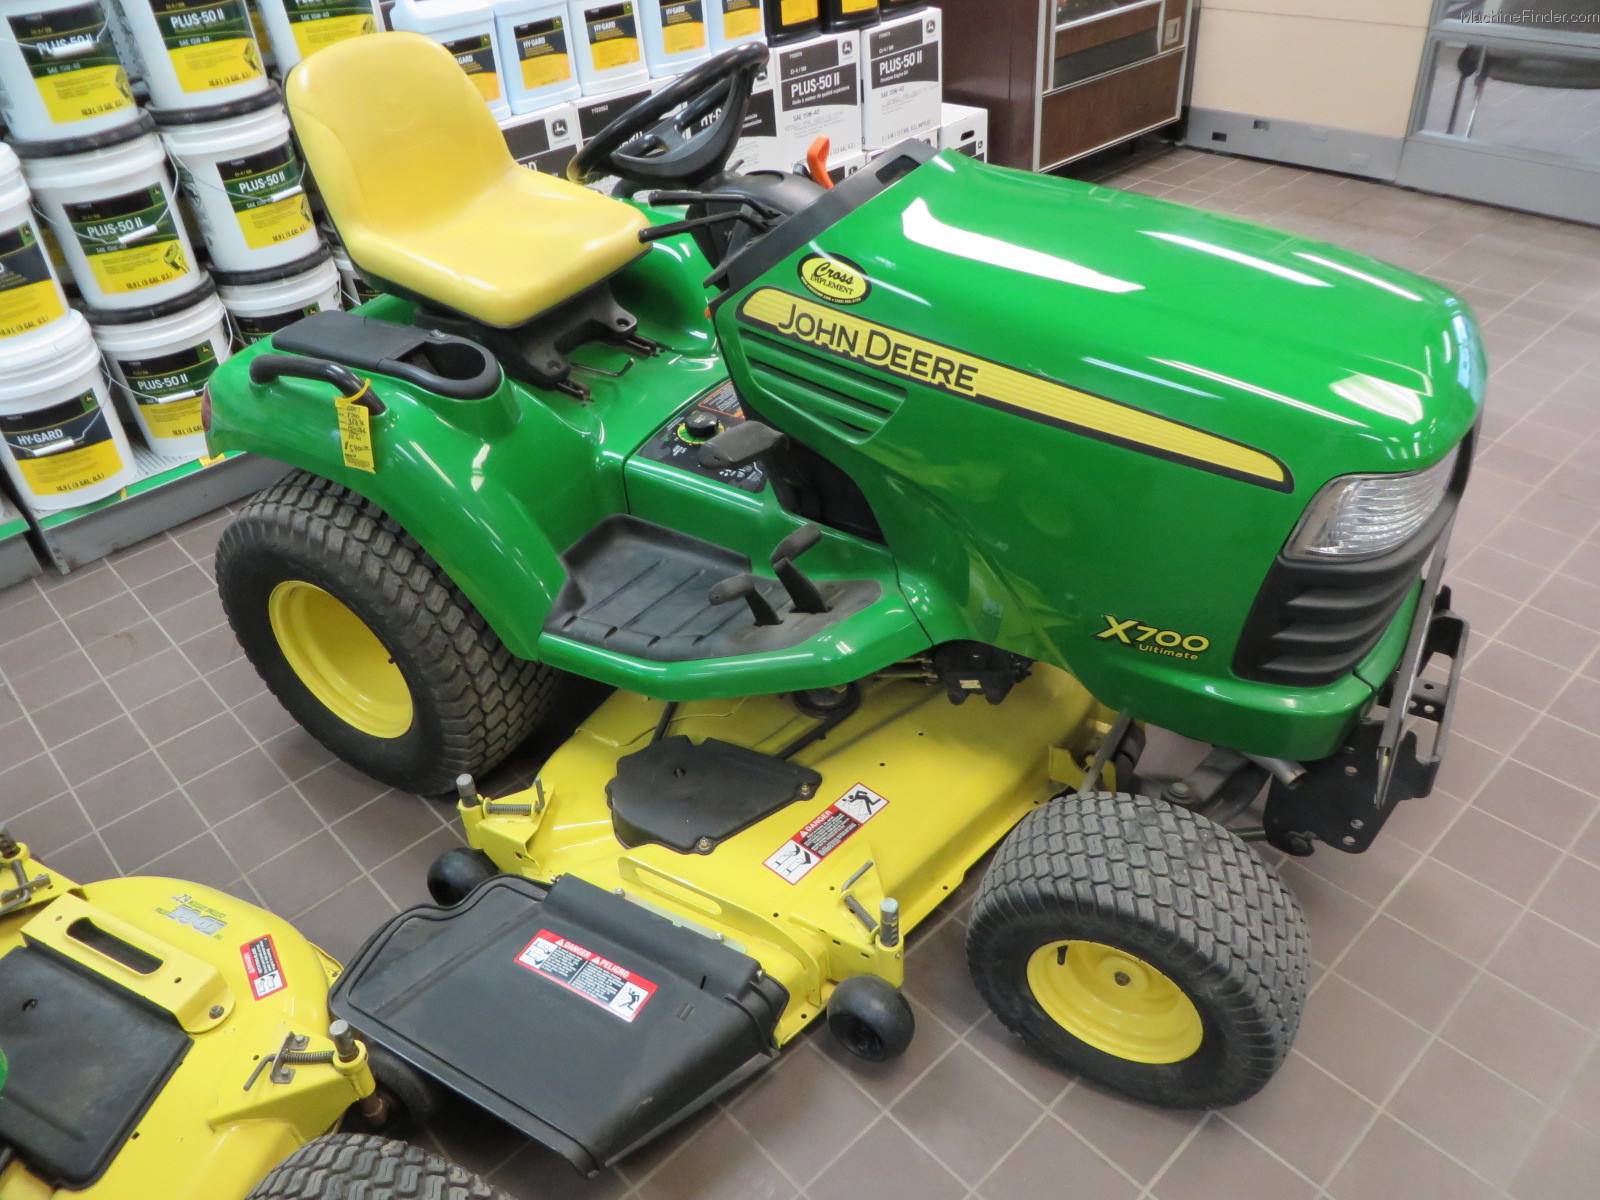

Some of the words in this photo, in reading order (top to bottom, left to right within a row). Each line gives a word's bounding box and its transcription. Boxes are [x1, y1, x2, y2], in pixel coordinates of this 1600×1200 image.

[170, 10, 216, 28] PLUS-50
[880, 51, 916, 76] PLUS-50
[916, 49, 923, 64] II
[791, 74, 832, 98] PLUS-50
[833, 71, 840, 86] II
[238, 173, 279, 193] PLUS-50
[87, 219, 134, 237] PLUS-50
[134, 216, 144, 227] II
[810, 273, 855, 296] IMPLEMENT
[814, 261, 854, 285] Cross
[778, 303, 859, 354] JOHN
[865, 328, 979, 393] DEERE
[137, 375, 180, 390] PLUS-50
[180, 373, 188, 383] II
[16, 428, 64, 446] HY-GARD
[1096, 614, 1210, 652] X700
[1139, 643, 1199, 660] Ultimate
[805, 809, 832, 833] DANGER
[166, 904, 228, 936] EDGE
[564, 941, 592, 959] DANGER
[600, 959, 630, 978] PELIGRO
